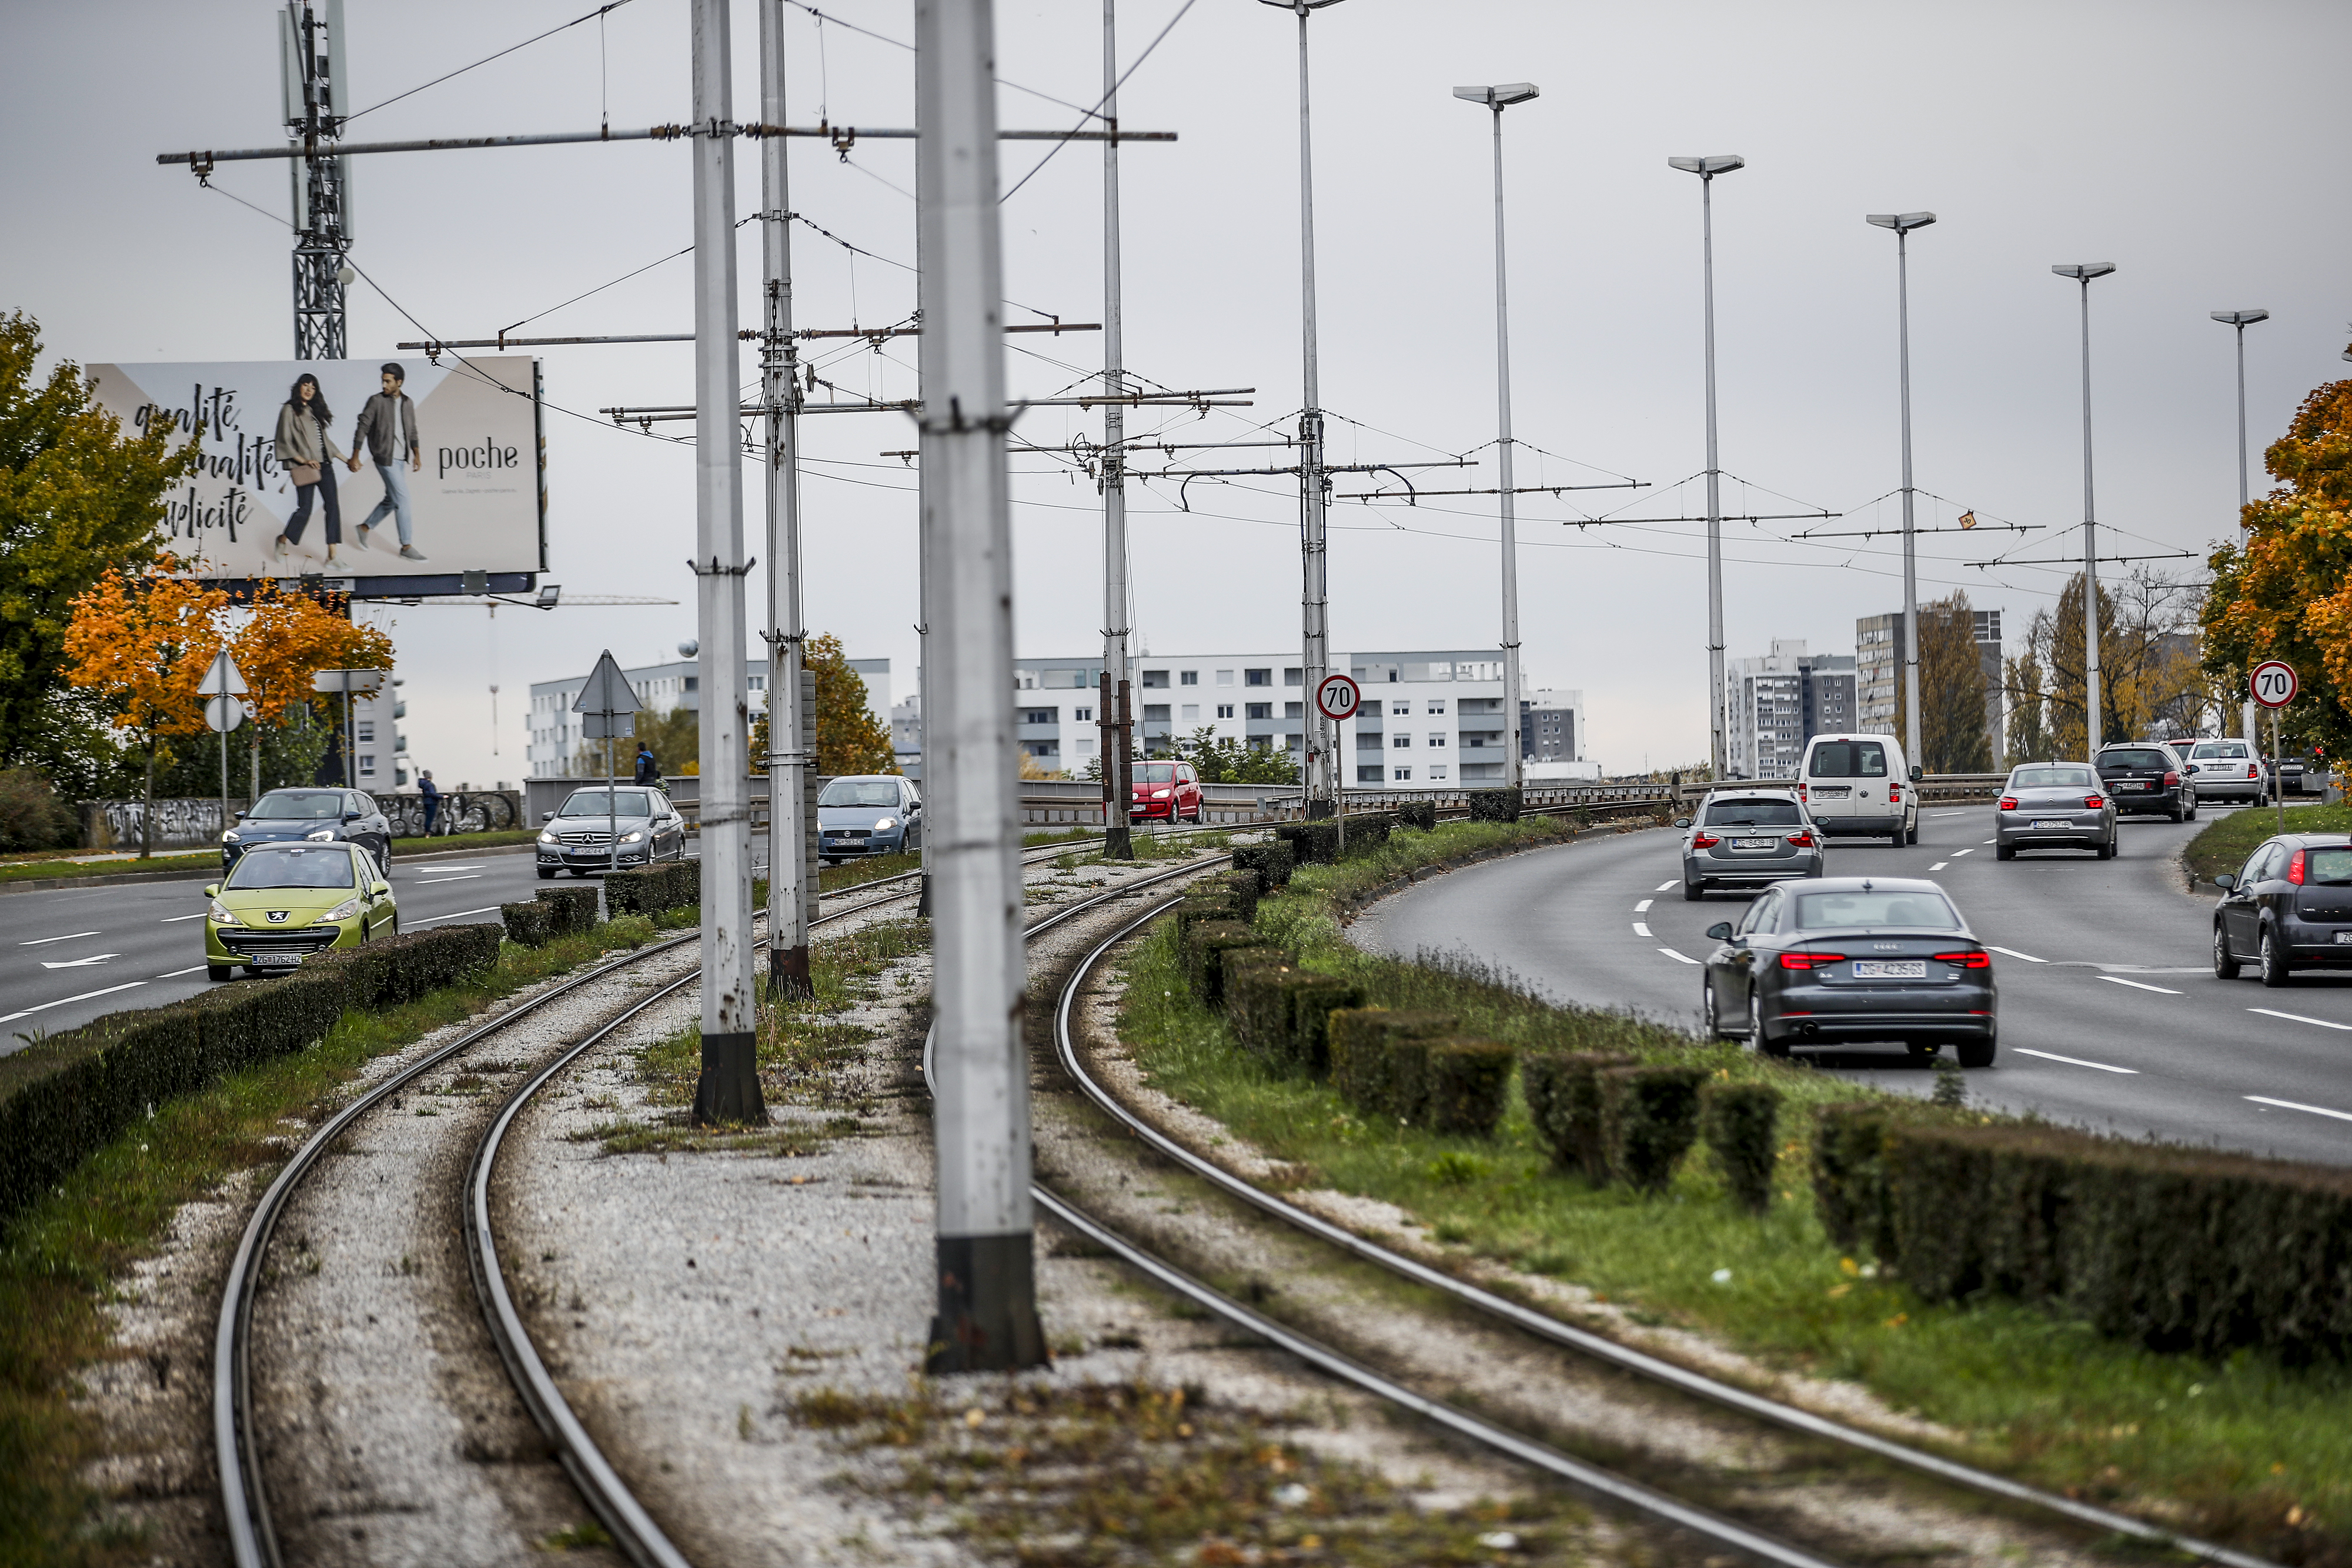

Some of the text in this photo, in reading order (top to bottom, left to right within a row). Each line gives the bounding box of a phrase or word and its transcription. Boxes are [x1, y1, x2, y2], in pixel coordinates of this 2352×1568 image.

[439, 436, 518, 480] poche
[2261, 673, 2286, 696] 70
[1327, 687, 1351, 708] 70
[1863, 964, 1876, 975] ZG
